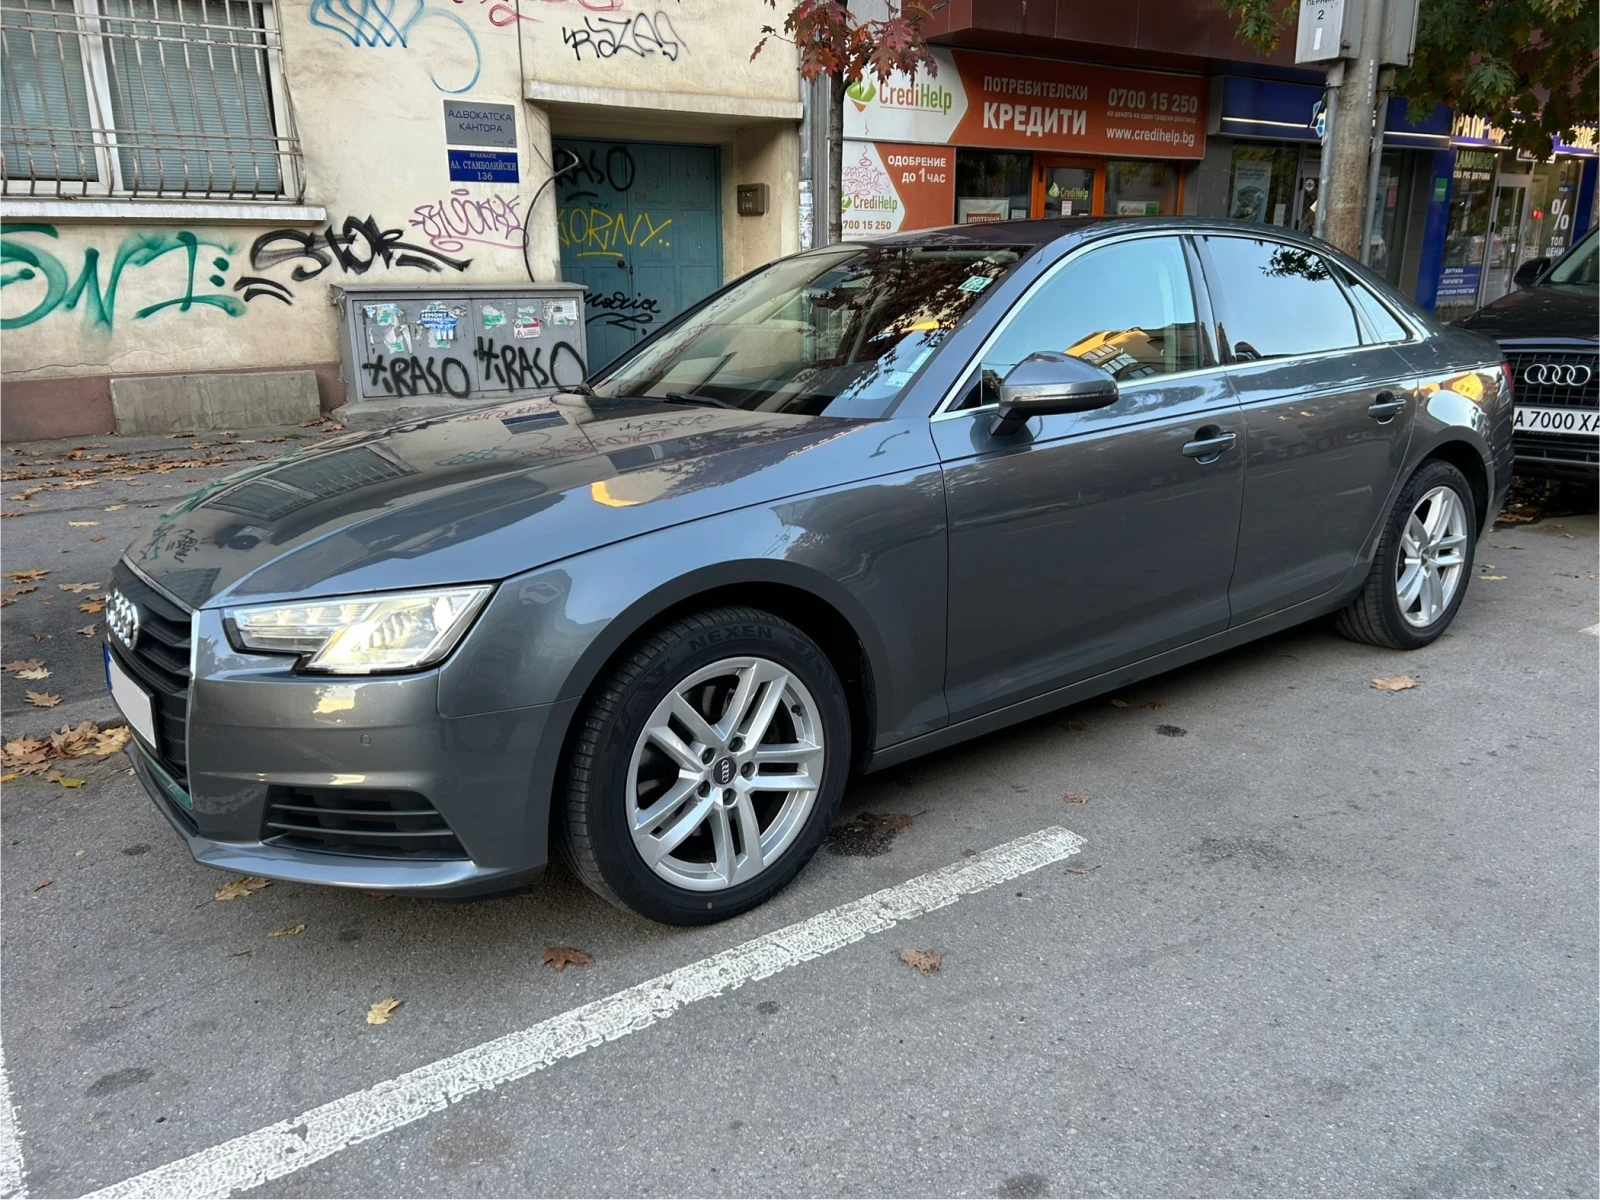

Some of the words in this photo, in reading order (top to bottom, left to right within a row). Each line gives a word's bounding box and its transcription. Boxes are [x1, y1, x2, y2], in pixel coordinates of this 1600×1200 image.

[1317, 9, 1325, 20] 2
[983, 75, 1089, 101] ПОТРЕБИТЕЛСКИ
[879, 80, 953, 115] CrediHelp
[1108, 88, 1146, 109] 0700
[1151, 92, 1168, 111] 15
[1171, 94, 1198, 114] 250
[447, 109, 513, 122] АДВОКАТСКА
[983, 101, 1088, 137] КРЕДИТИ
[459, 123, 504, 133] КАНТОРА
[1106, 127, 1195, 147] www.credihelp.bg
[450, 160, 461, 169] АЛ.
[462, 159, 517, 171] СТАМБОЛИЙСКИ
[887, 155, 947, 167] ОДОБРЕНИЕ
[477, 171, 493, 181] 136
[901, 172, 916, 183] ДО
[918, 167, 925, 183] 1
[927, 173, 946, 183] ЧАС
[853, 194, 898, 213] CrediHelp
[842, 220, 860, 230] 700
[863, 220, 873, 230] 15
[875, 221, 891, 230] 250
[1529, 411, 1575, 429] 7000
[688, 625, 772, 653] NEXEN
